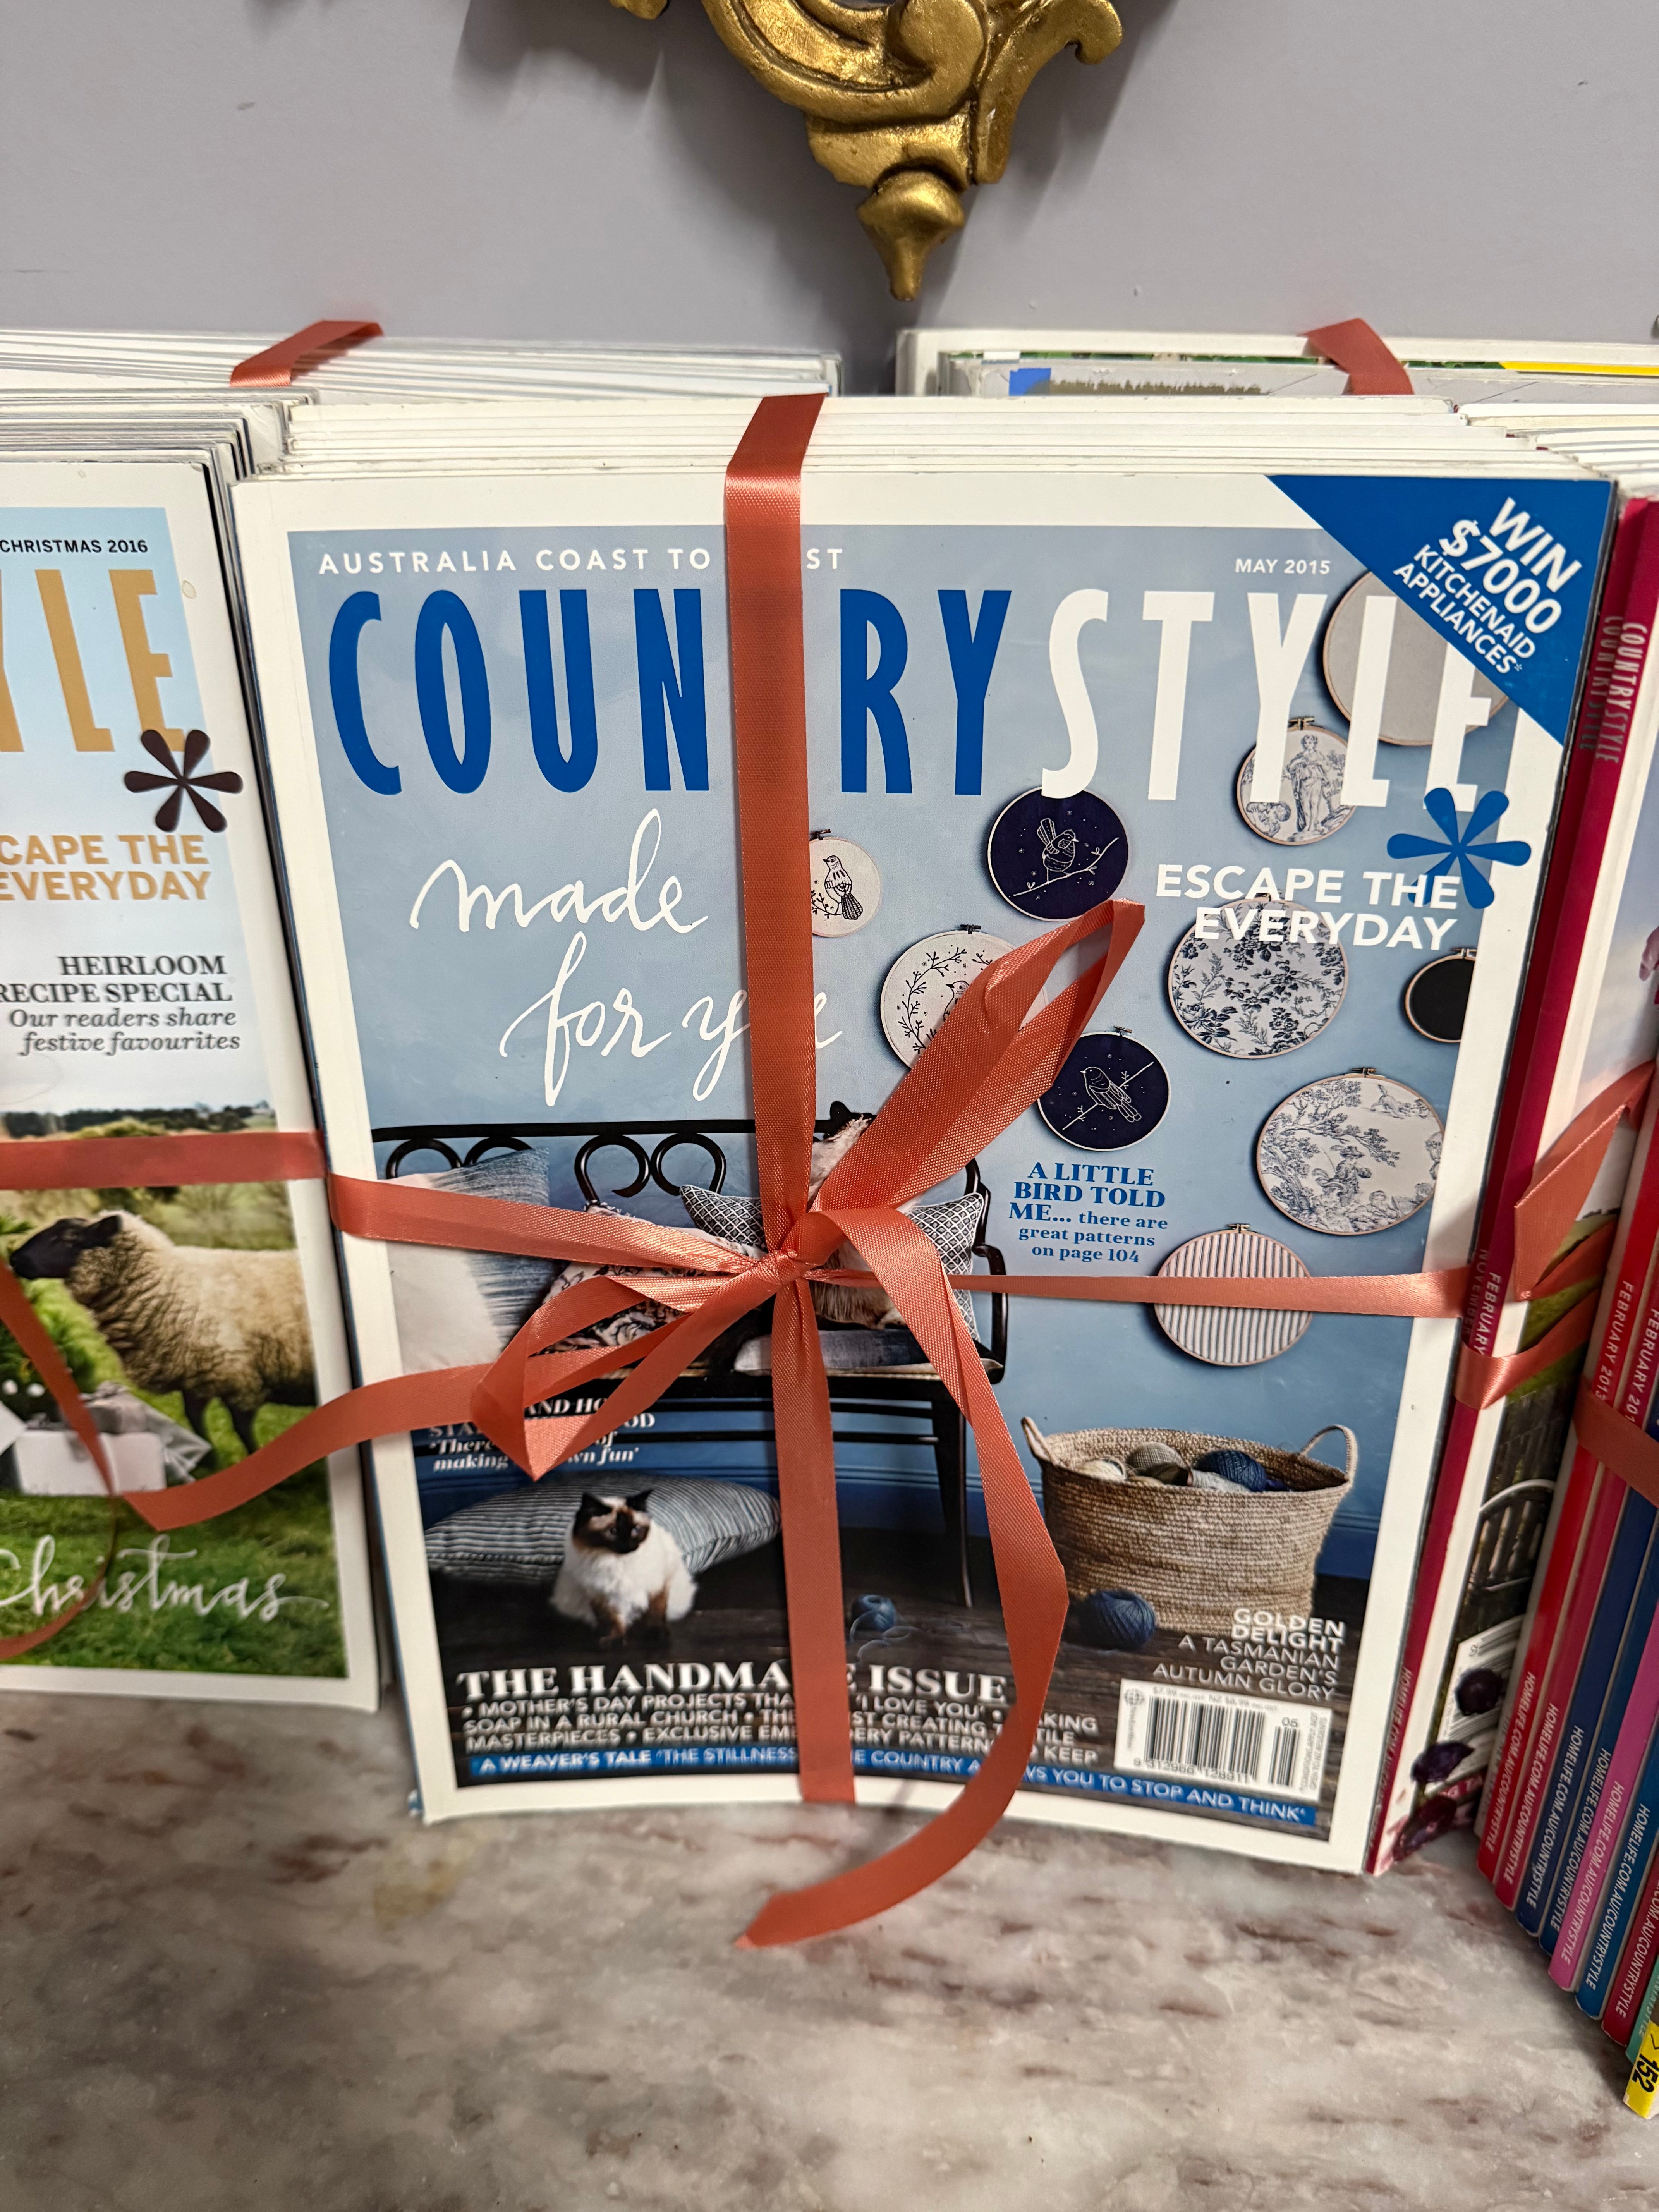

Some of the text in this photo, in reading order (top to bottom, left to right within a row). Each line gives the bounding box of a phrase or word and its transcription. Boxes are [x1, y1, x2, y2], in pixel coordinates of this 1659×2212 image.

[0, 540, 148, 553] CHRISTMAS 2016
[319, 550, 516, 575] AUSTRALIA
[536, 549, 649, 571] COAST
[668, 548, 711, 570] TO
[1489, 497, 1582, 593] WIN
[1235, 558, 1331, 575] MAY 2015
[1439, 520, 1562, 634] $7000
[1413, 544, 1536, 658] KITCHENAID
[329, 589, 1012, 796] COUNRY
[118, 835, 210, 865] THE
[410, 808, 708, 934] made
[1156, 864, 1461, 910] ESCAPE THE
[1194, 907, 1458, 950] EVERYDAY
[57, 955, 228, 976] HEIRLOOM
[0, 982, 233, 1003] RECIPE SPECIAL
[10, 1007, 237, 1027] Our readers share
[500, 931, 672, 1106] for
[19, 1030, 240, 1056] festive favourites
[1027, 1162, 1154, 1186] A LITTLE
[1013, 1182, 1166, 1207] BIRD TOLD
[1008, 1202, 1168, 1230] ME... there are
[1019, 1228, 1155, 1246] great patterns
[1032, 1246, 1139, 1263] on page 104
[1473, 1271, 1501, 1355] FEBRUARY
[1605, 1280, 1634, 1364] FEBRUARY
[1625, 1308, 1659, 1423] FEBRUARY 201
[433, 1453, 509, 1472] making
[1231, 1624, 1345, 1654] DELIGHT
[1233, 1607, 1345, 1638] GOLDEN
[1178, 1634, 1340, 1671] A TASMANIAN
[455, 1667, 560, 1702] THE
[869, 1664, 1008, 1705] ISSUE
[1152, 1662, 1337, 1702] AUTUMN GLORY
[1220, 1656, 1338, 1687] GARDEN'S
[464, 1716, 522, 1737] SOAP
[526, 1715, 551, 1733] IN
[555, 1714, 572, 1731] A
[576, 1710, 646, 1731] RURAL
[650, 1709, 738, 1728] CHURCH
[881, 1713, 986, 1739] CREATING
[478, 1696, 589, 1719] MOTHER'S
[593, 1695, 637, 1713] DAY
[641, 1693, 747, 1714] PROJECTS
[874, 1695, 928, 1716] LOVE
[1281, 1716, 1299, 1728] 05
[465, 1728, 621, 1755] MASTERPIECES
[642, 1724, 753, 1746] EXCLUSIVE
[1044, 1743, 1099, 1768] KEEP
[479, 1757, 496, 1774] A
[499, 1751, 601, 1772] WEAVER'S
[603, 1749, 651, 1766] TALE
[703, 1746, 799, 1765] STILLNESS
[871, 1750, 963, 1775] COUNTRY
[1052, 1767, 1095, 1788] YOU
[1098, 1774, 1128, 1795] TO
[1131, 1778, 1183, 1798] STOP
[1186, 1788, 1234, 1808] AND
[1503, 1702, 1558, 1884] HOMELIFE.COM.AU/COUNTRYSTYLE
[1526, 1724, 1585, 1910] HOMELIFE.COM.AU/COUNTRYSTYLE
[1550, 1747, 1612, 1932] HOMELIFE.COM.AU/COUNTRYSTYLE
[1560, 1780, 1625, 1966] HOMELIFE.COM.AU/COUNTRYSTYLE
[1586, 1802, 1651, 1991] HOMELIFE.COM.AU/COUNTRYSTYLE
